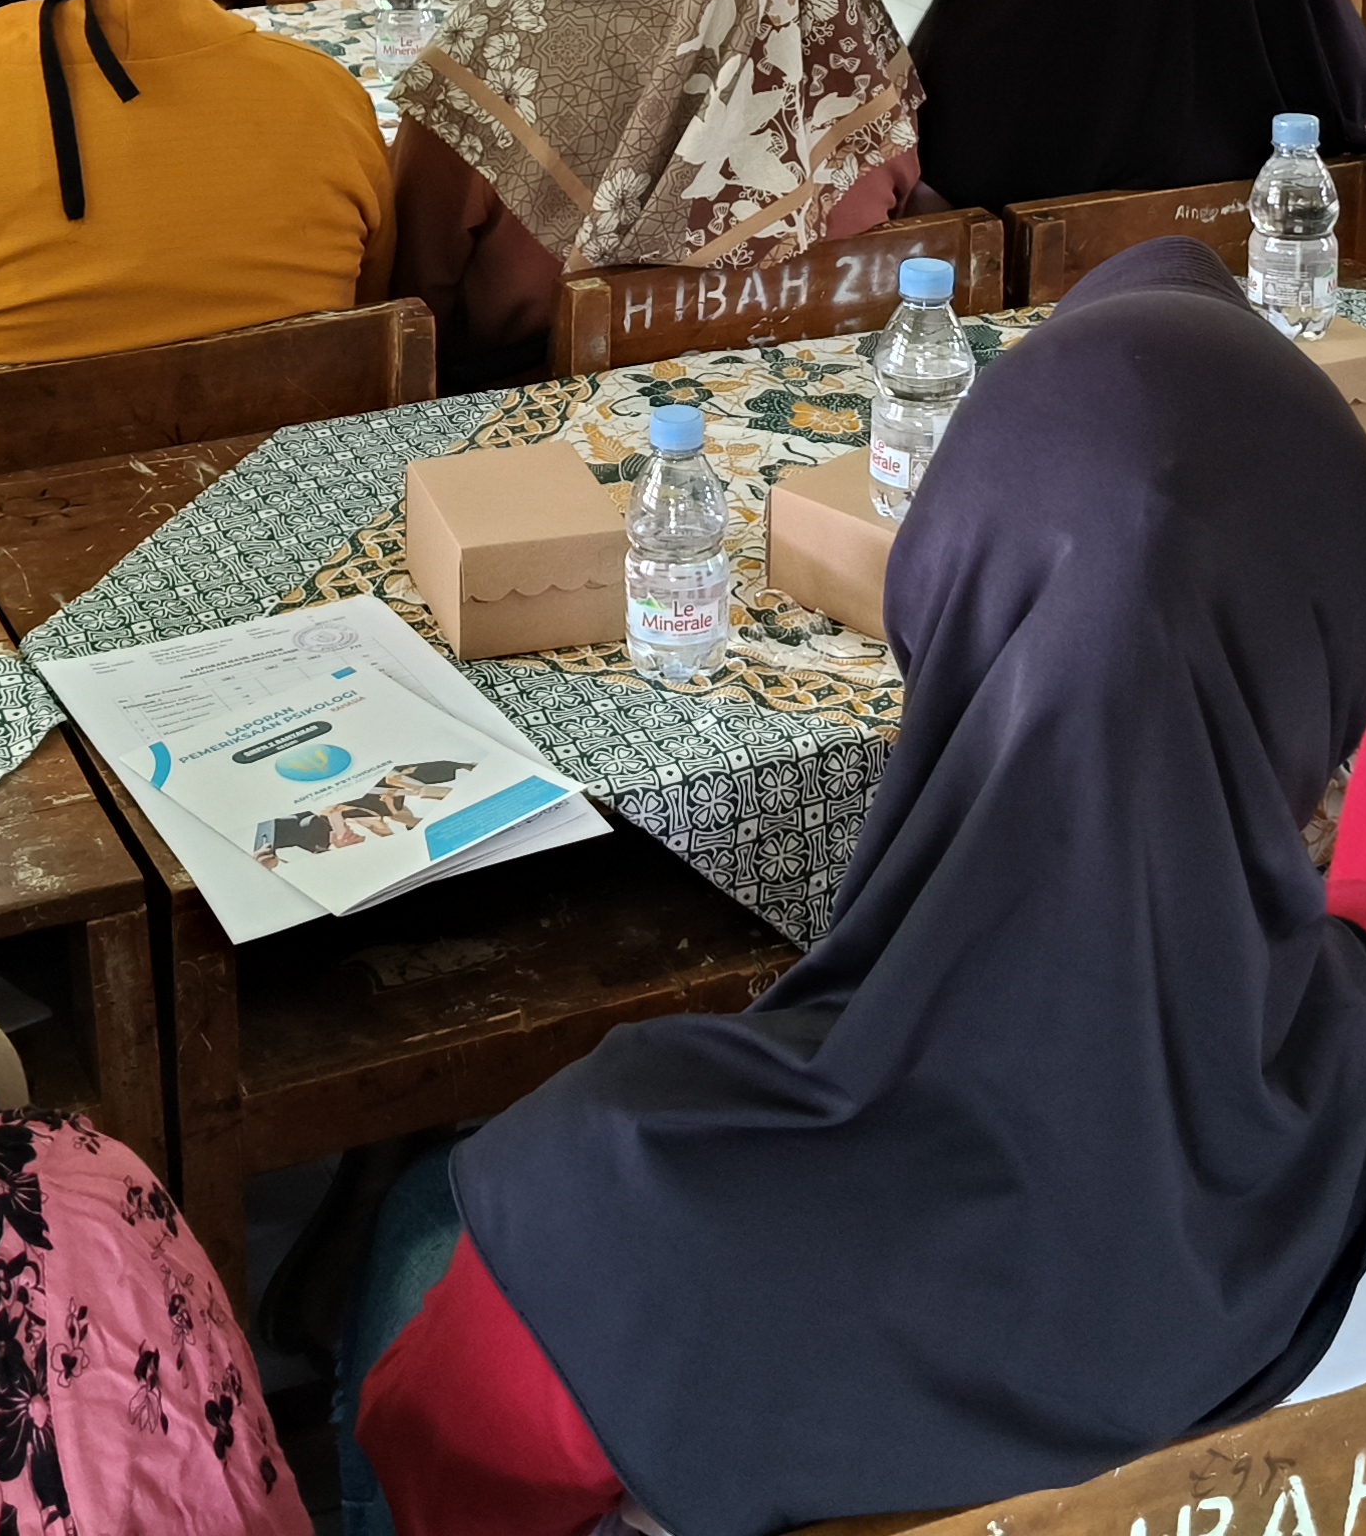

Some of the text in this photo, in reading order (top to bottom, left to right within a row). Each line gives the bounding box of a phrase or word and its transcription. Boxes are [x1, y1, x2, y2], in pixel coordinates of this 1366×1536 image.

[400, 36, 413, 47] Le
[623, 264, 809, 333] HIBAH
[872, 453, 900, 473] erale
[674, 600, 694, 617] Le
[642, 611, 713, 632] Minerale
[178, 689, 358, 764] PEMERIKSAAN PSIKOLOGI
[225, 707, 294, 737] LAPORAN
